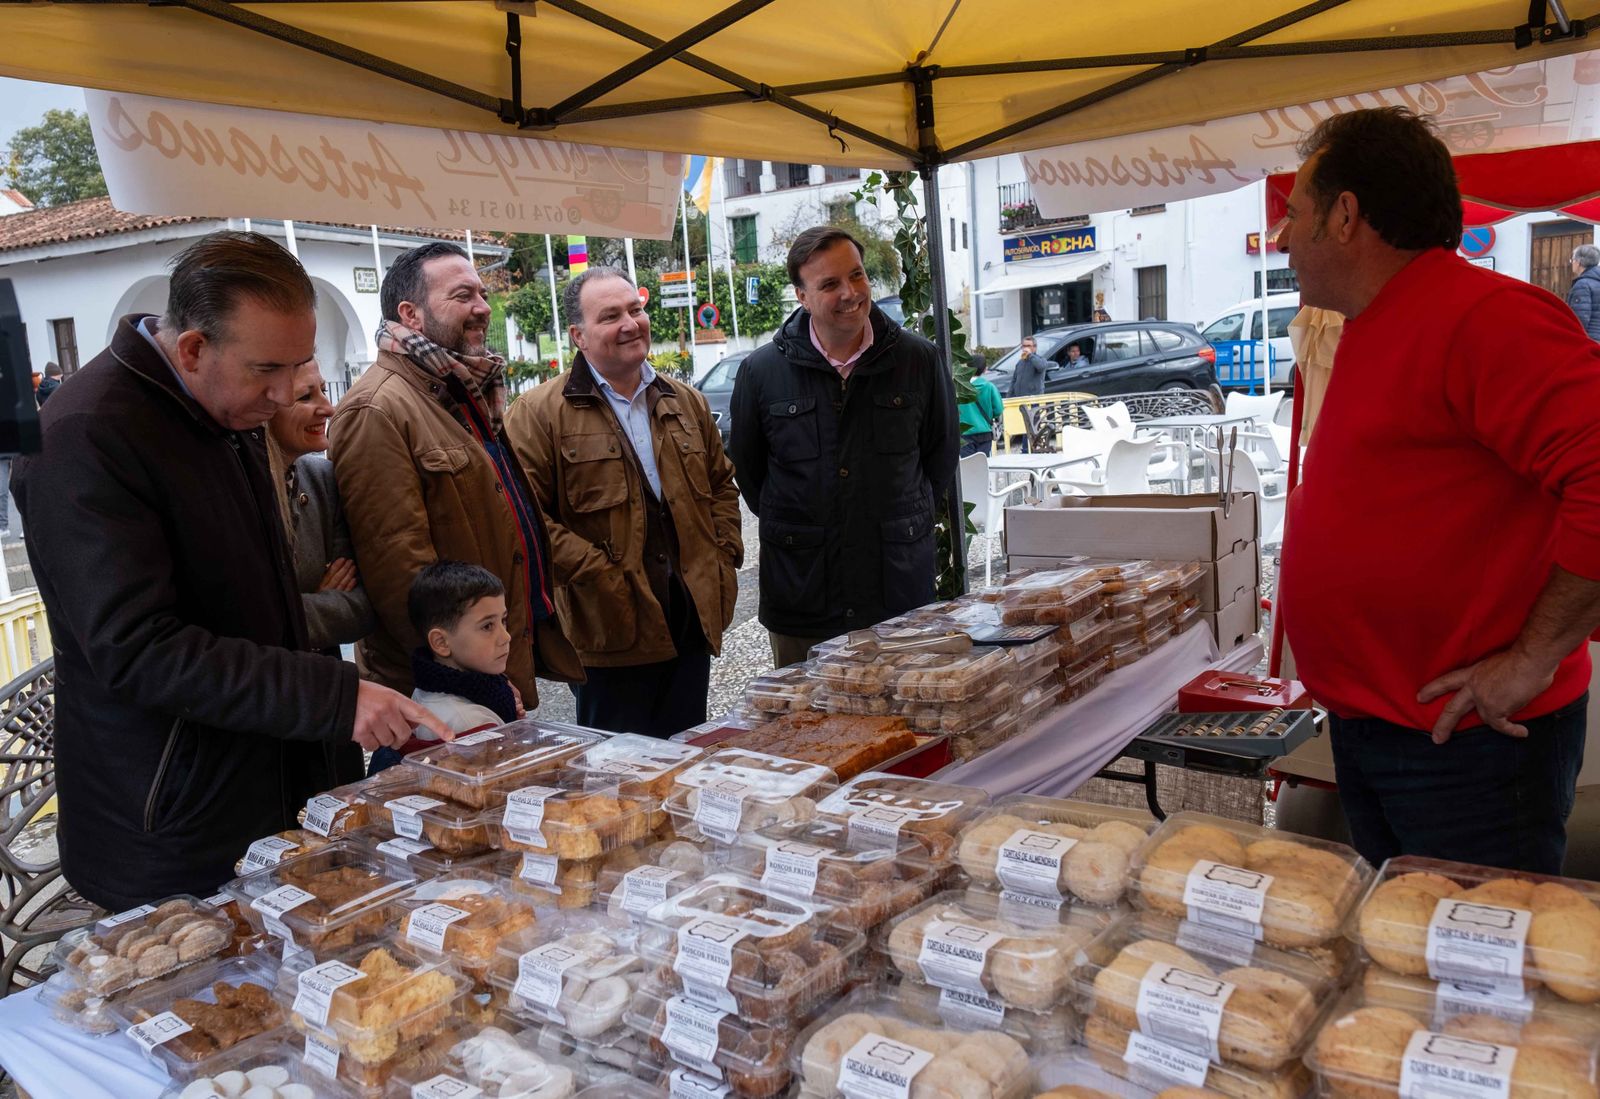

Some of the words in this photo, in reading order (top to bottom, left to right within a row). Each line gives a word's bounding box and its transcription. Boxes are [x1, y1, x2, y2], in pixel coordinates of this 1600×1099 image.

[1041, 235, 1094, 255] ROCHA
[851, 822, 873, 833] ROSCOS
[1003, 848, 1020, 860] TORTAS
[1028, 855, 1057, 868] ALMENDRAS
[769, 862, 792, 872] ROSCOS
[794, 867, 816, 878] FRITOS
[1435, 926, 1470, 940] TORTAS
[1472, 932, 1485, 943] DE
[682, 945, 705, 959] ROSCOS
[707, 953, 730, 967] FRITOS
[926, 939, 944, 953] TORTAS
[953, 947, 983, 962] ALMENDRAS
[1146, 990, 1173, 1001] TORTAS
[1186, 1001, 1219, 1015] NARANJA
[669, 1010, 693, 1025] ROSCOS
[694, 1020, 717, 1034] FRITOS
[846, 1058, 866, 1074] TORTAS
[875, 1069, 907, 1088] ALMENDRAS
[1410, 1060, 1449, 1078] TORTAS
[1451, 1068, 1465, 1081] DE
